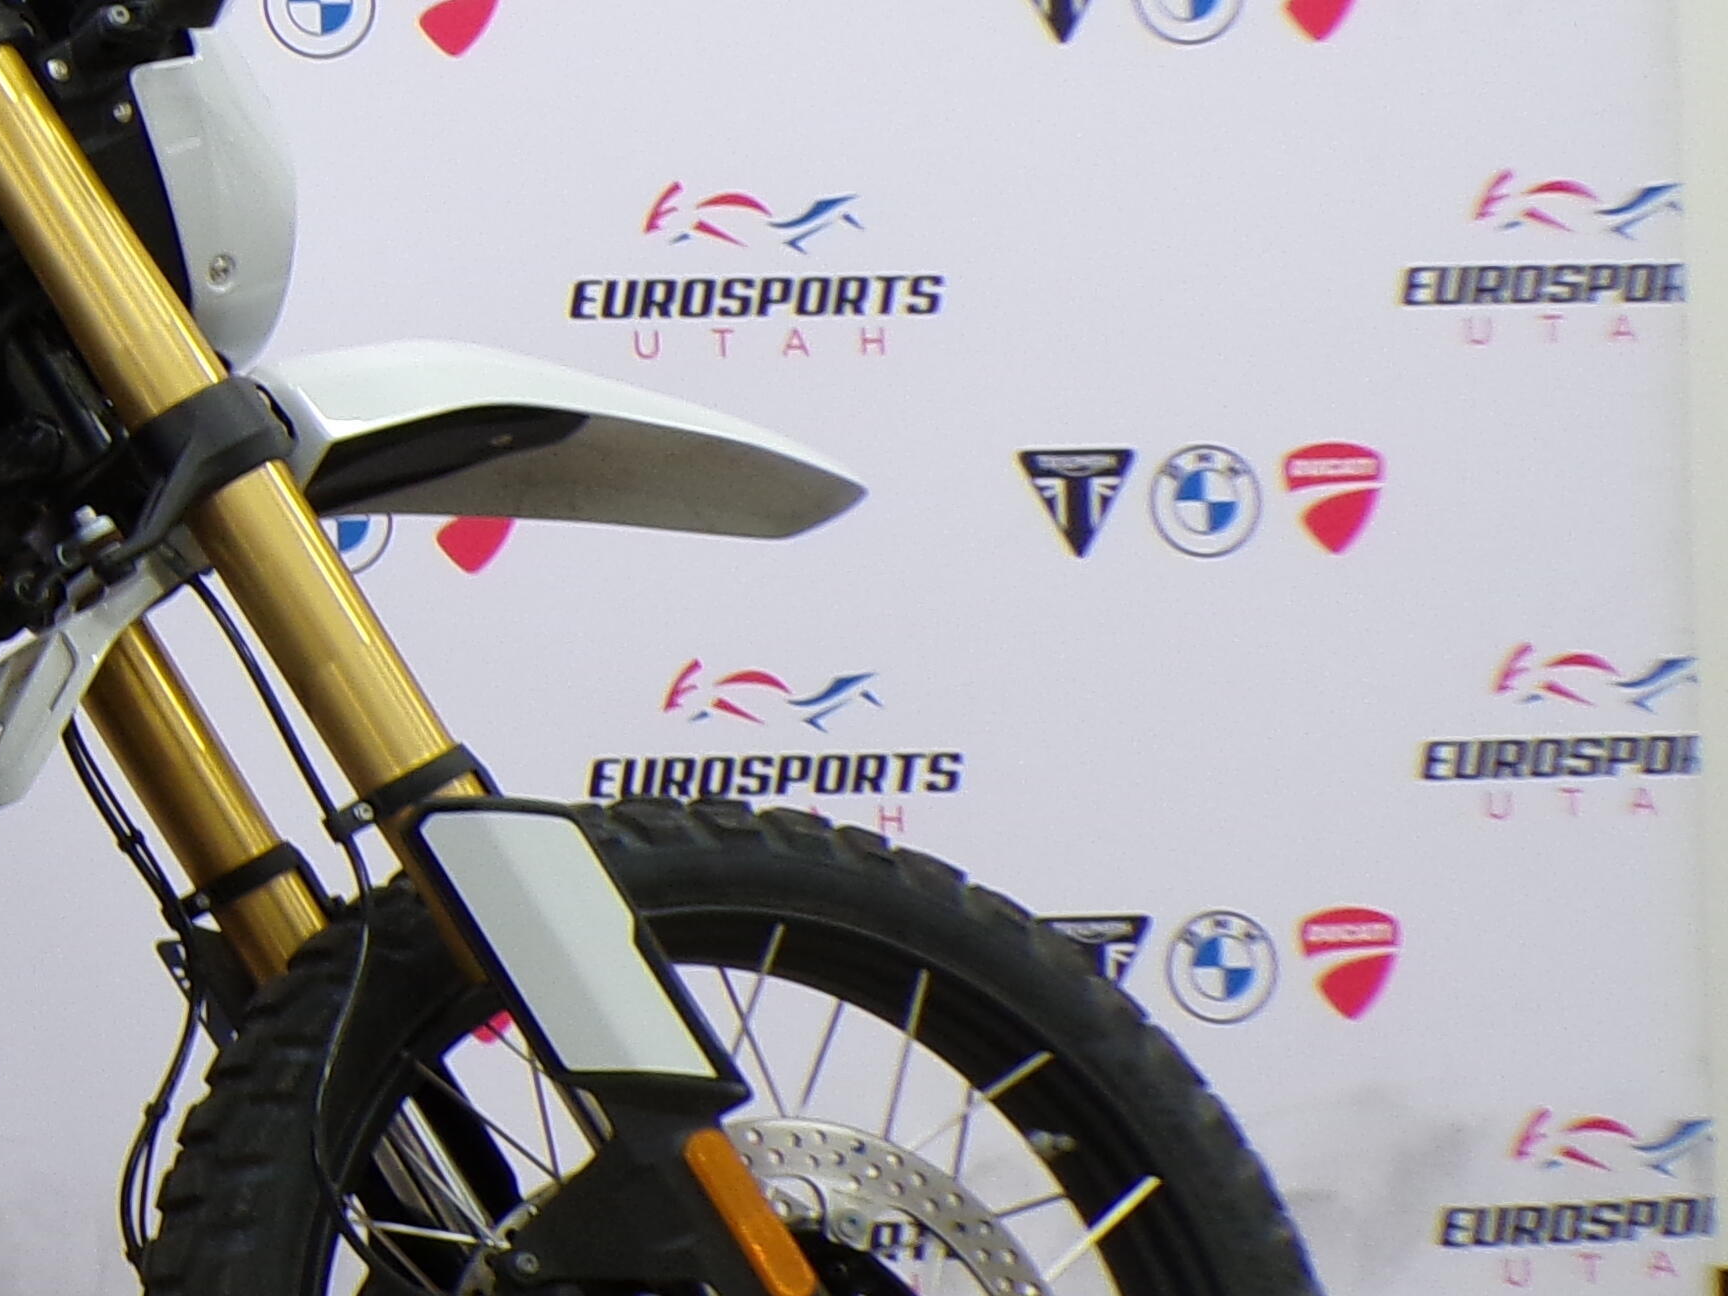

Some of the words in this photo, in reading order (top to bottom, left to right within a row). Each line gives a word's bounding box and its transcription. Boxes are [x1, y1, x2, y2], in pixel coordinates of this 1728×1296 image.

[570, 276, 942, 319] EUROSPORTS
[633, 327, 888, 360] UTAH
[589, 753, 961, 796] EUROSPORTS
[1439, 1197, 1709, 1248] EUROSPO
